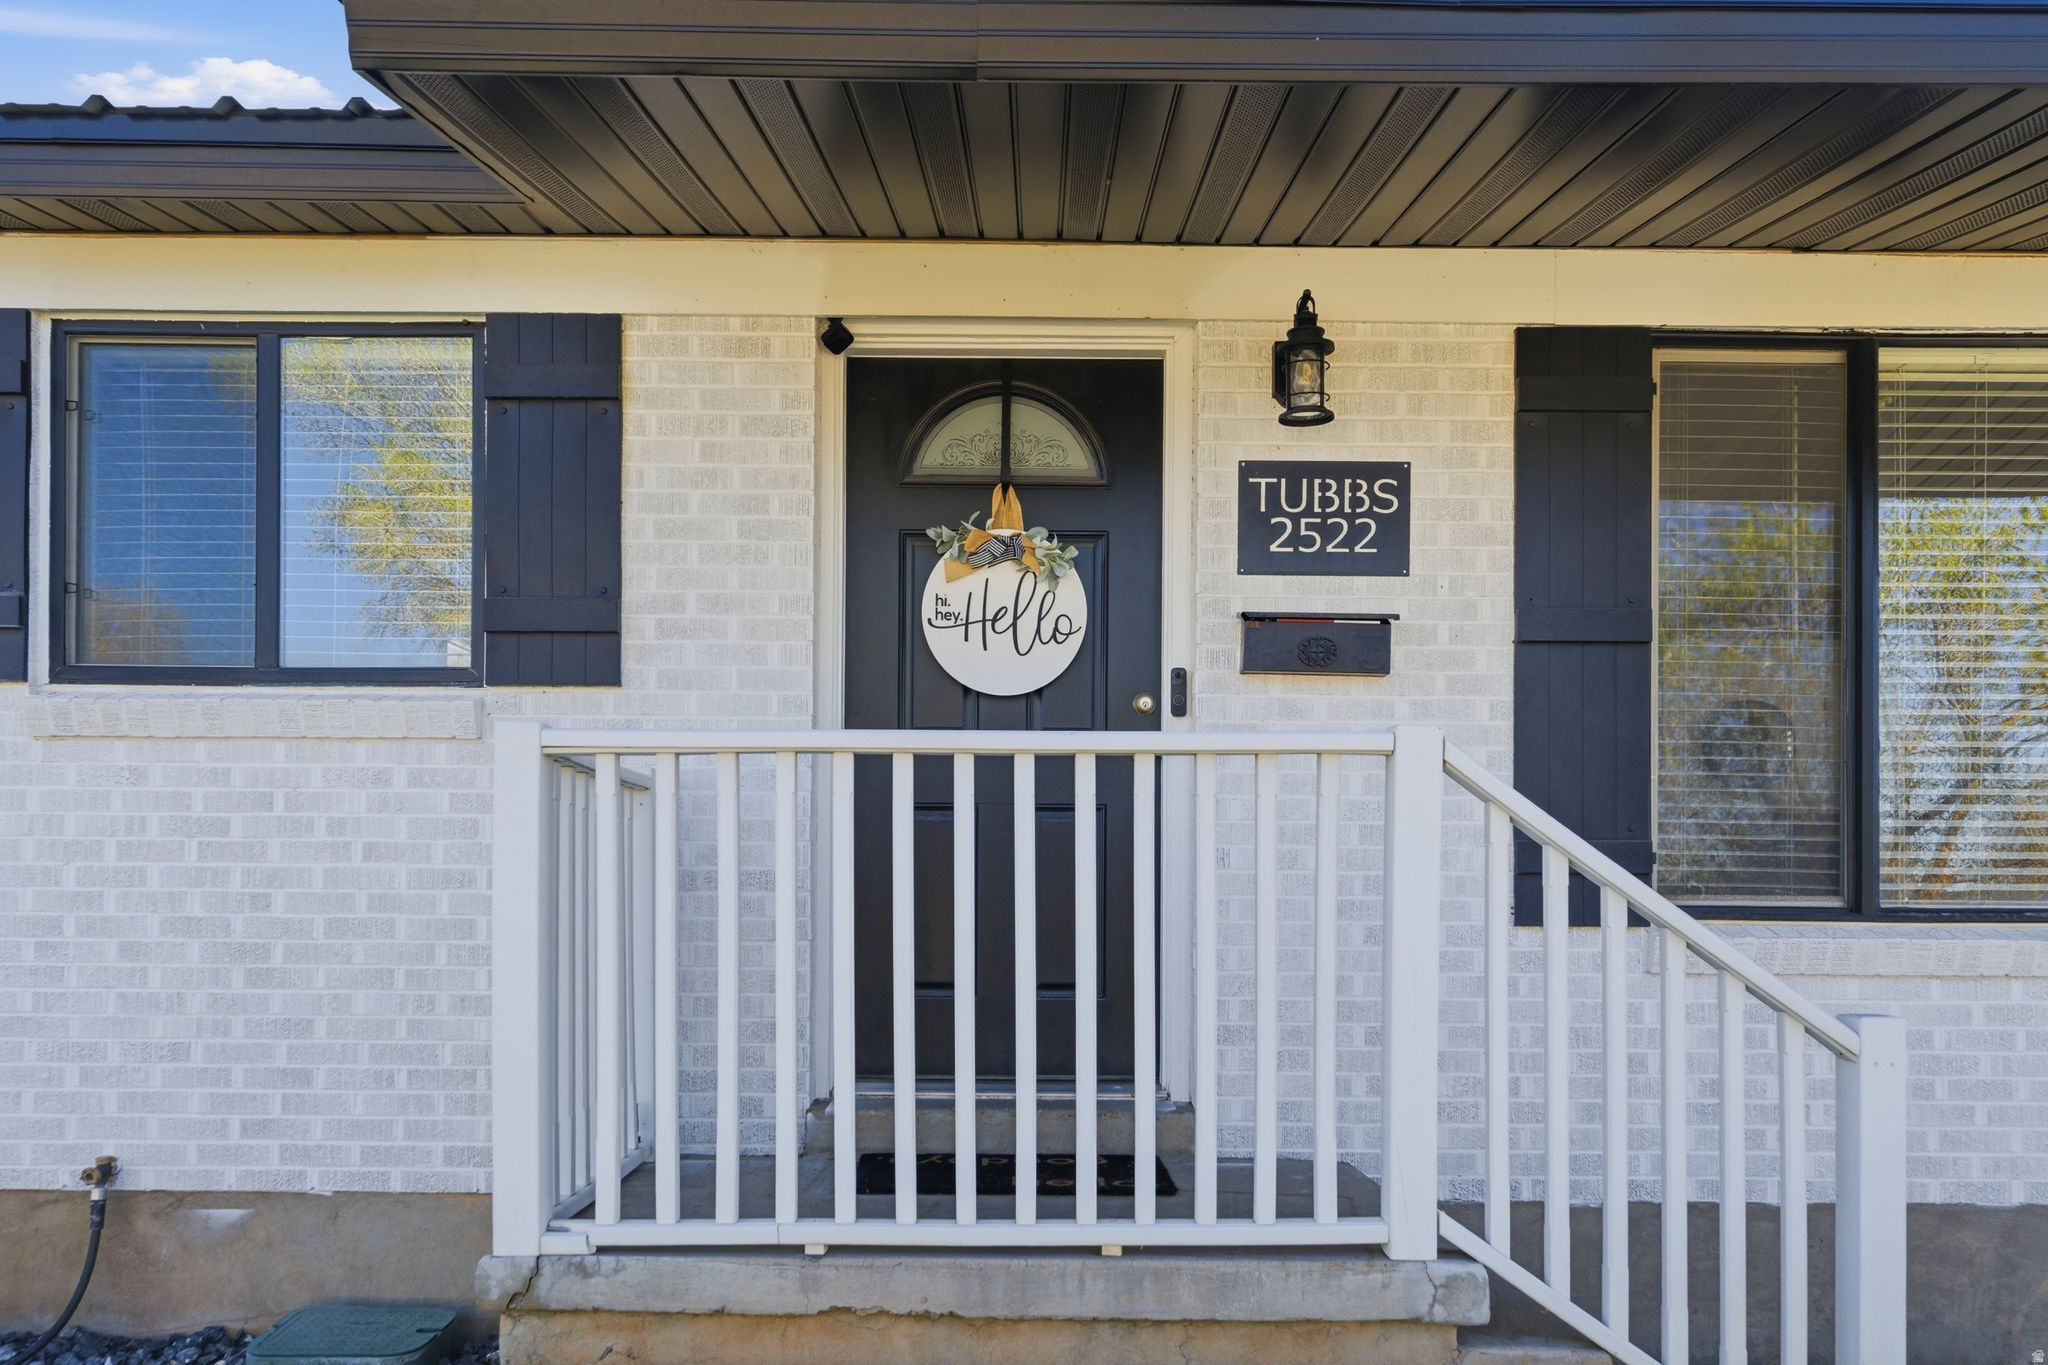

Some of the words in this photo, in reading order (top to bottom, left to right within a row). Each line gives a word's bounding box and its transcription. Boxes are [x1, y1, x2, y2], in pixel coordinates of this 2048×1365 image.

[1248, 477, 1399, 514] TUBBS
[1269, 516, 1378, 553] 2522
[927, 570, 1082, 656] Hello
[935, 593, 951, 607] hi.
[935, 608, 963, 624] hey.
